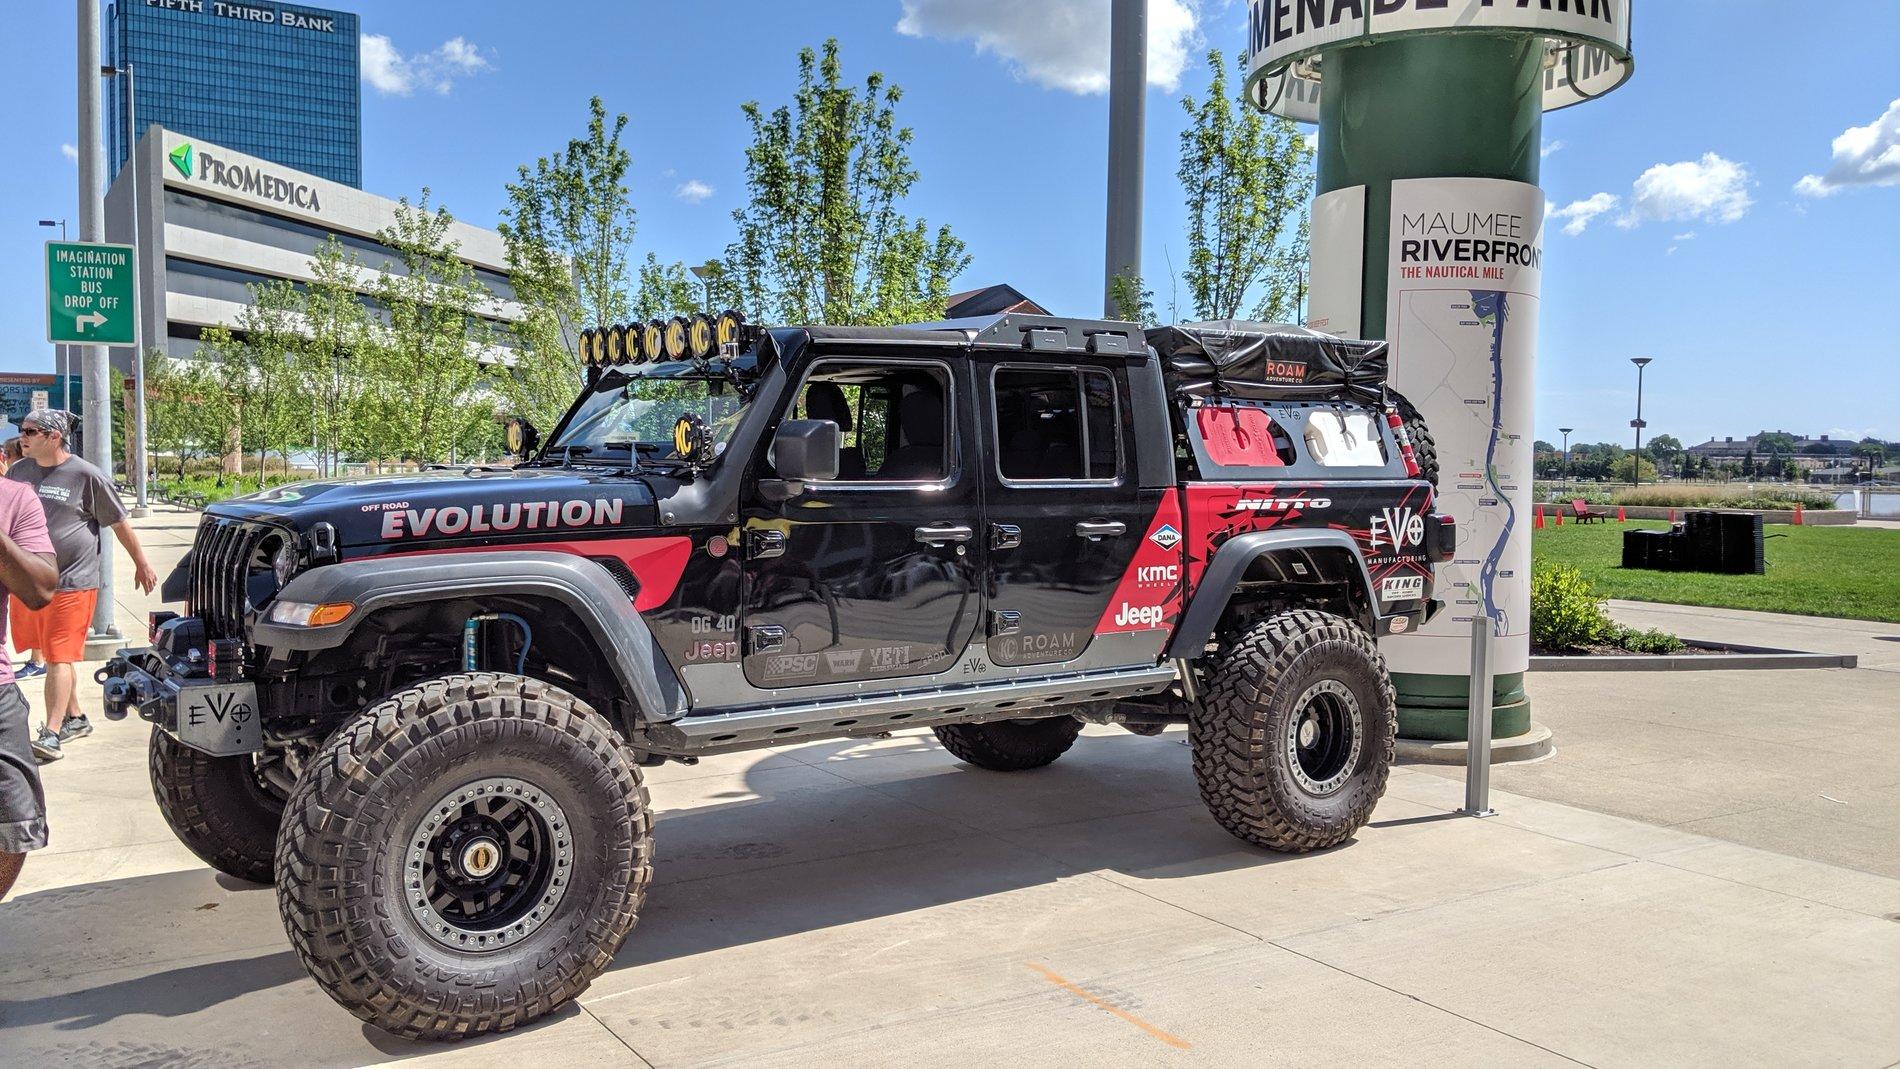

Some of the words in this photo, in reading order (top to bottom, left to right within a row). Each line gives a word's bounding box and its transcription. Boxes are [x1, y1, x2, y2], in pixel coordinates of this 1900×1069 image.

[214, 1, 275, 23] THIRD
[281, 11, 335, 33] BANK
[1402, 212, 1522, 239] MAUMEE
[56, 249, 126, 266] IMAGINATION
[1401, 239, 1542, 271] RIVERFRONT
[70, 265, 114, 280] STATION
[1401, 266, 1421, 279] THE
[1425, 266, 1479, 279] NAUTICAL
[1483, 267, 1504, 280] MILE
[80, 280, 103, 294] BUS
[64, 295, 93, 308] DROP
[99, 297, 119, 310] OFF
[626, 328, 639, 359] KC
[692, 320, 709, 354] KC
[1267, 362, 1305, 377] ROAM
[676, 420, 692, 456] KC
[382, 501, 409, 510] ROAD
[1234, 497, 1332, 511] NITTO
[381, 498, 623, 539] EVOLUTION
[1370, 507, 1424, 555] EVO
[1367, 554, 1427, 565] MANUFACTURING
[1138, 565, 1178, 582] KMC
[1384, 578, 1421, 590] KING
[717, 615, 736, 632] 40
[1115, 602, 1163, 627] Jeep
[684, 641, 739, 661] Jeep
[1000, 638, 1016, 660] KC
[1023, 633, 1075, 651] ROAM
[779, 655, 817, 673] PSC
[870, 645, 910, 666] YETI
[1023, 650, 1062, 660] ADVENTURE
[188, 692, 252, 727] EVO
